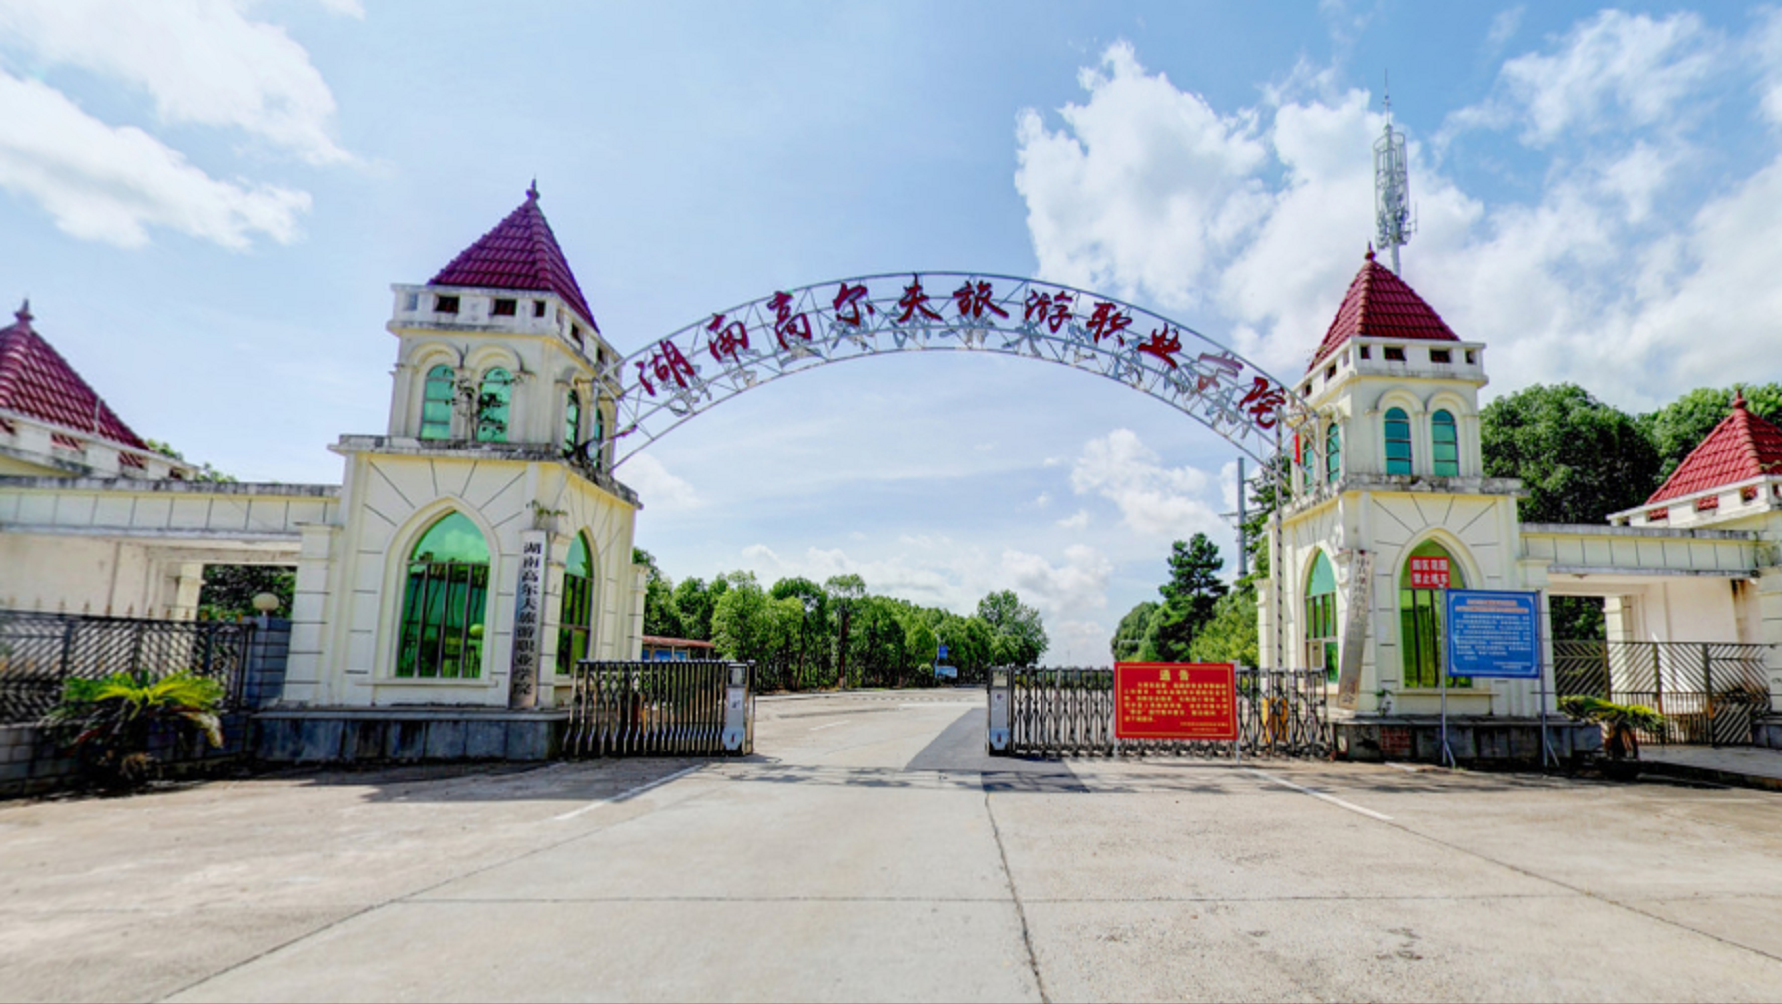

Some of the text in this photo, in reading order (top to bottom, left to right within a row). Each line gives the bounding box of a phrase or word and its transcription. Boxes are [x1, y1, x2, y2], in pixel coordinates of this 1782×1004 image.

[513, 542, 541, 695] 湖南高尔夫旅游职业学院
